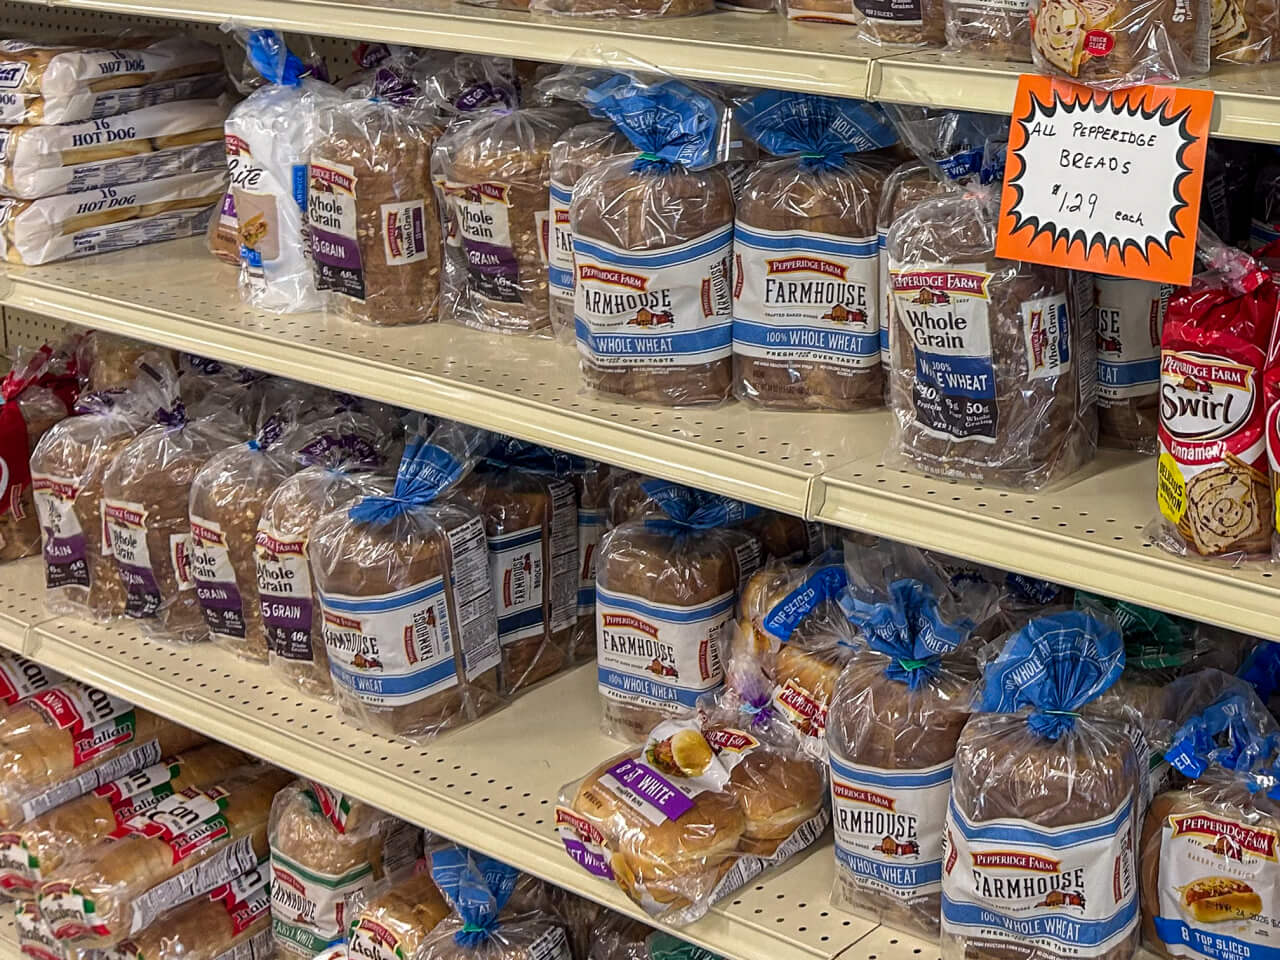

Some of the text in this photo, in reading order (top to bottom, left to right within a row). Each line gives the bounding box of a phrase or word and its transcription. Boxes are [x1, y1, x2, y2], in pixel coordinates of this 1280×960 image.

[72, 127, 136, 147] HOT DOG
[1030, 122, 1157, 147] ALL PEPPERIDGE
[1059, 149, 1131, 174] BREADS
[77, 194, 136, 214] HOT DOG
[1051, 184, 1144, 226] $1.29 each
[310, 210, 342, 229] Grain
[320, 240, 345, 258] GRAIN
[772, 261, 842, 276] PEPPERIDGE FARM
[620, 273, 642, 288] FARM
[946, 274, 979, 290] FARM
[765, 278, 867, 307] FARMHOUSE
[906, 310, 968, 332] Whole
[597, 337, 673, 353] WHOLE WHEAT
[765, 330, 863, 353] 100% WHOLE WHEAT
[912, 328, 965, 350] Grain
[948, 373, 988, 391] WHEAT
[1211, 367, 1242, 384] FARM
[1161, 383, 1234, 424] Swirl
[197, 587, 228, 600] GRAIN
[257, 574, 293, 593] Grain
[272, 604, 301, 620] GRAIN
[603, 630, 676, 664] FARMHOUSE
[358, 679, 383, 693] WHEAT
[622, 676, 678, 701] WHOLE WHEAT
[848, 856, 917, 884] WHOLE WHEAT
[977, 855, 1053, 872] PEPPERIDGE FARM
[973, 868, 1085, 900] FARMHOUSE
[1003, 916, 1080, 940] WHOLE WHEAT
[1181, 926, 1250, 957] 8 TOP SLICED
